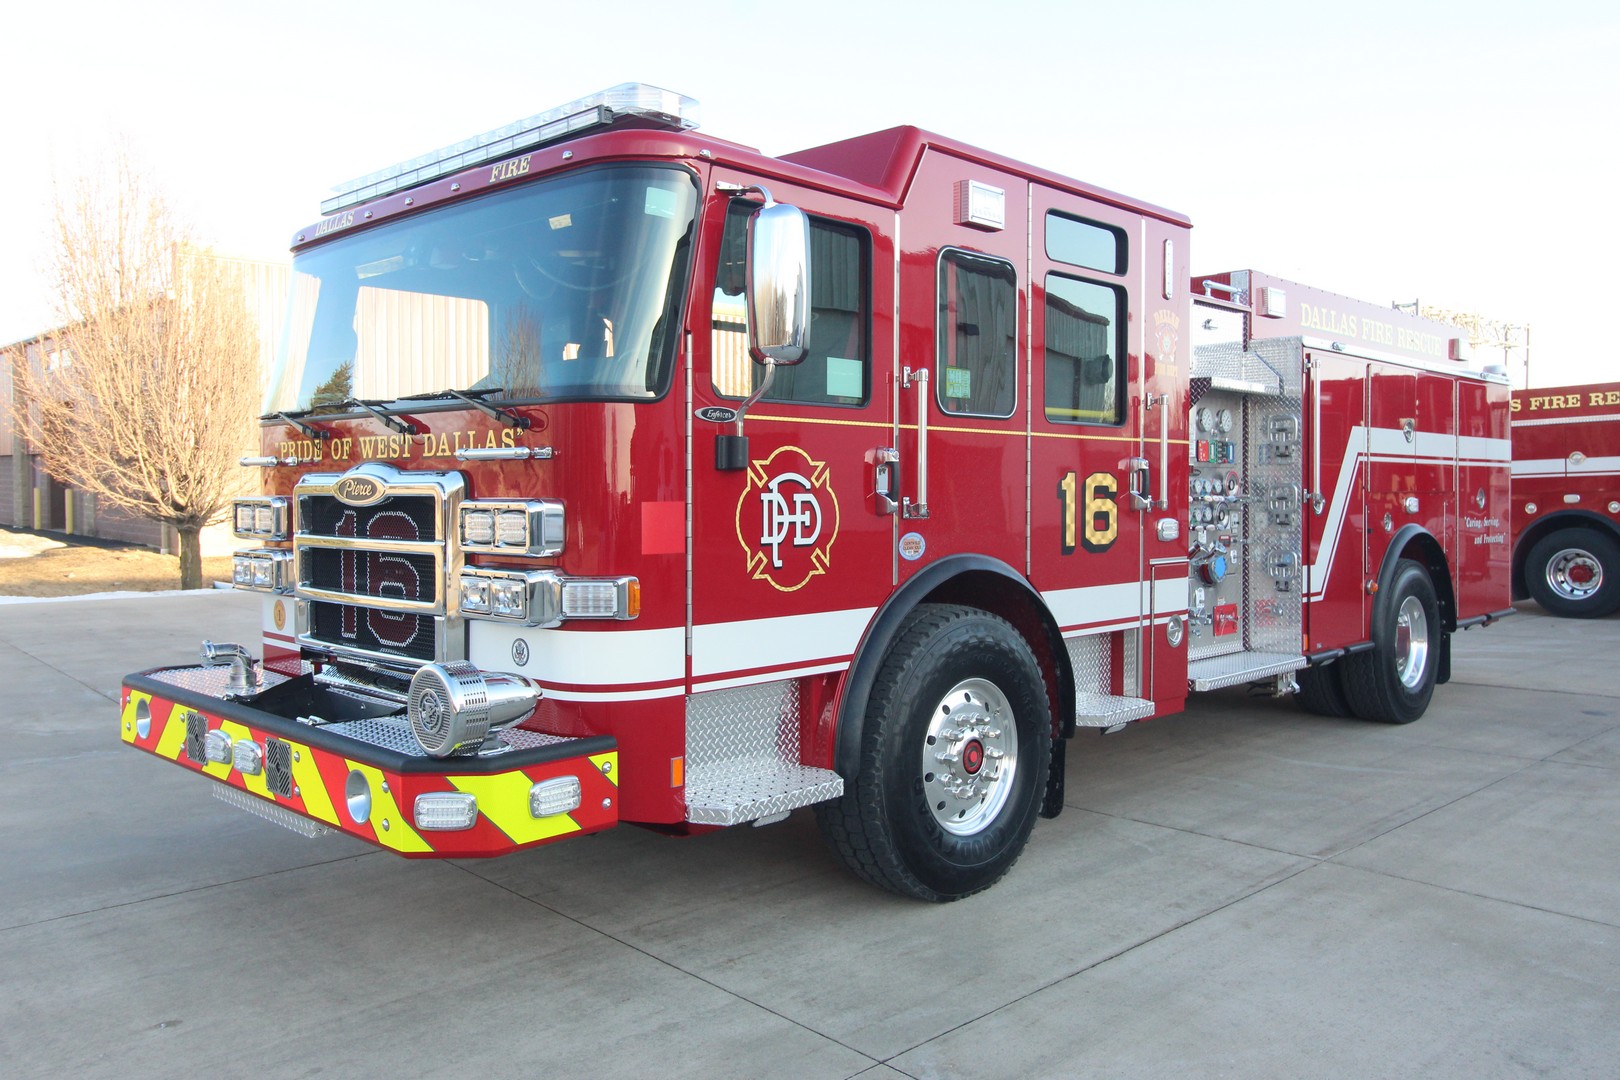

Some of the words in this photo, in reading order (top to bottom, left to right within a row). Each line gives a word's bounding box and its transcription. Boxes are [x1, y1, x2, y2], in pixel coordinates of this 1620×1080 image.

[314, 211, 354, 237] DALLAS
[489, 155, 532, 183] FIRE
[1300, 302, 1358, 338] DALLAS
[1361, 318, 1394, 345] FIRE
[1397, 328, 1442, 357] RESCUE
[1529, 394, 1581, 411] FIRE
[331, 437, 352, 459] OF
[359, 434, 414, 459] WEST
[343, 479, 373, 498] Pierce
[1059, 471, 1118, 552] 16
[1474, 534, 1483, 545] and
